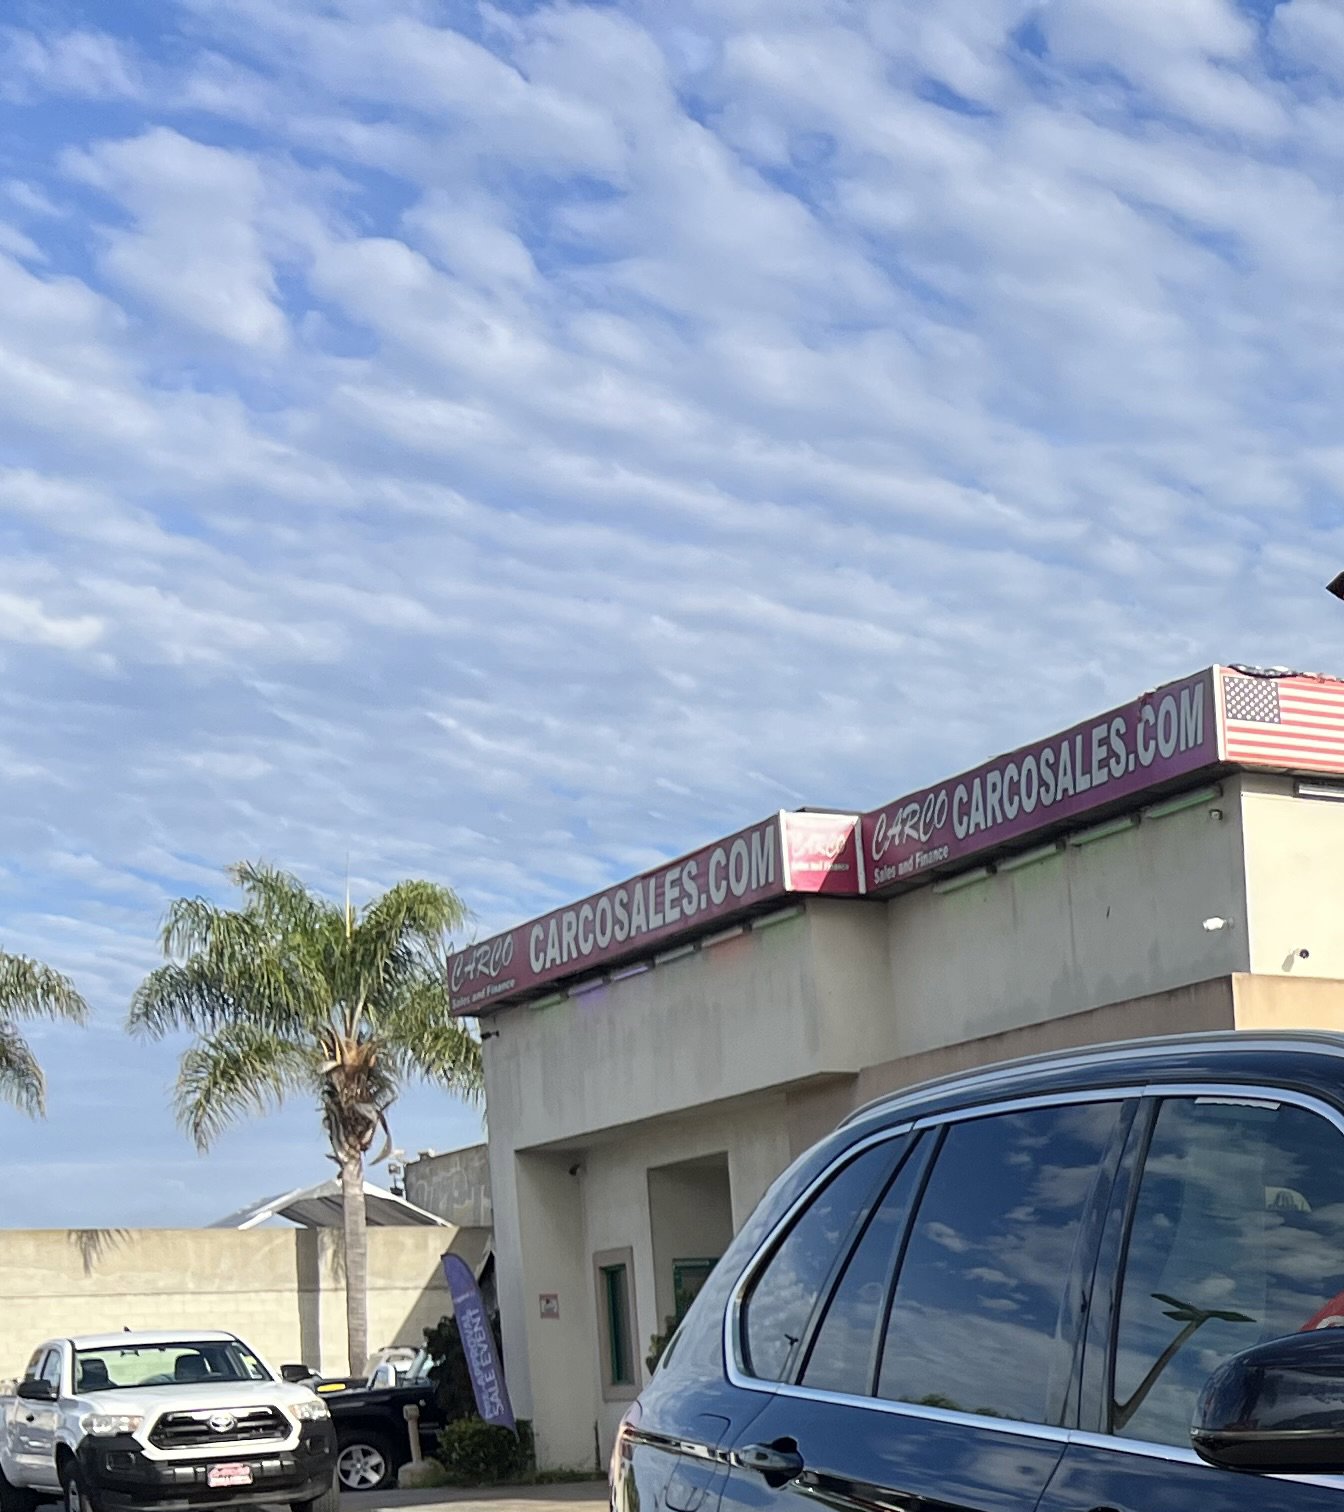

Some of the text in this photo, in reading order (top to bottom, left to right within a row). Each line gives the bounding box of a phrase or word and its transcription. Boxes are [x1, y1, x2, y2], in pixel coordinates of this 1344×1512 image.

[953, 682, 1204, 840] CARCOSALES.COM
[872, 789, 948, 861] CARCO
[529, 825, 775, 974] CARCOSALES.COM
[450, 933, 514, 993] CARCO
